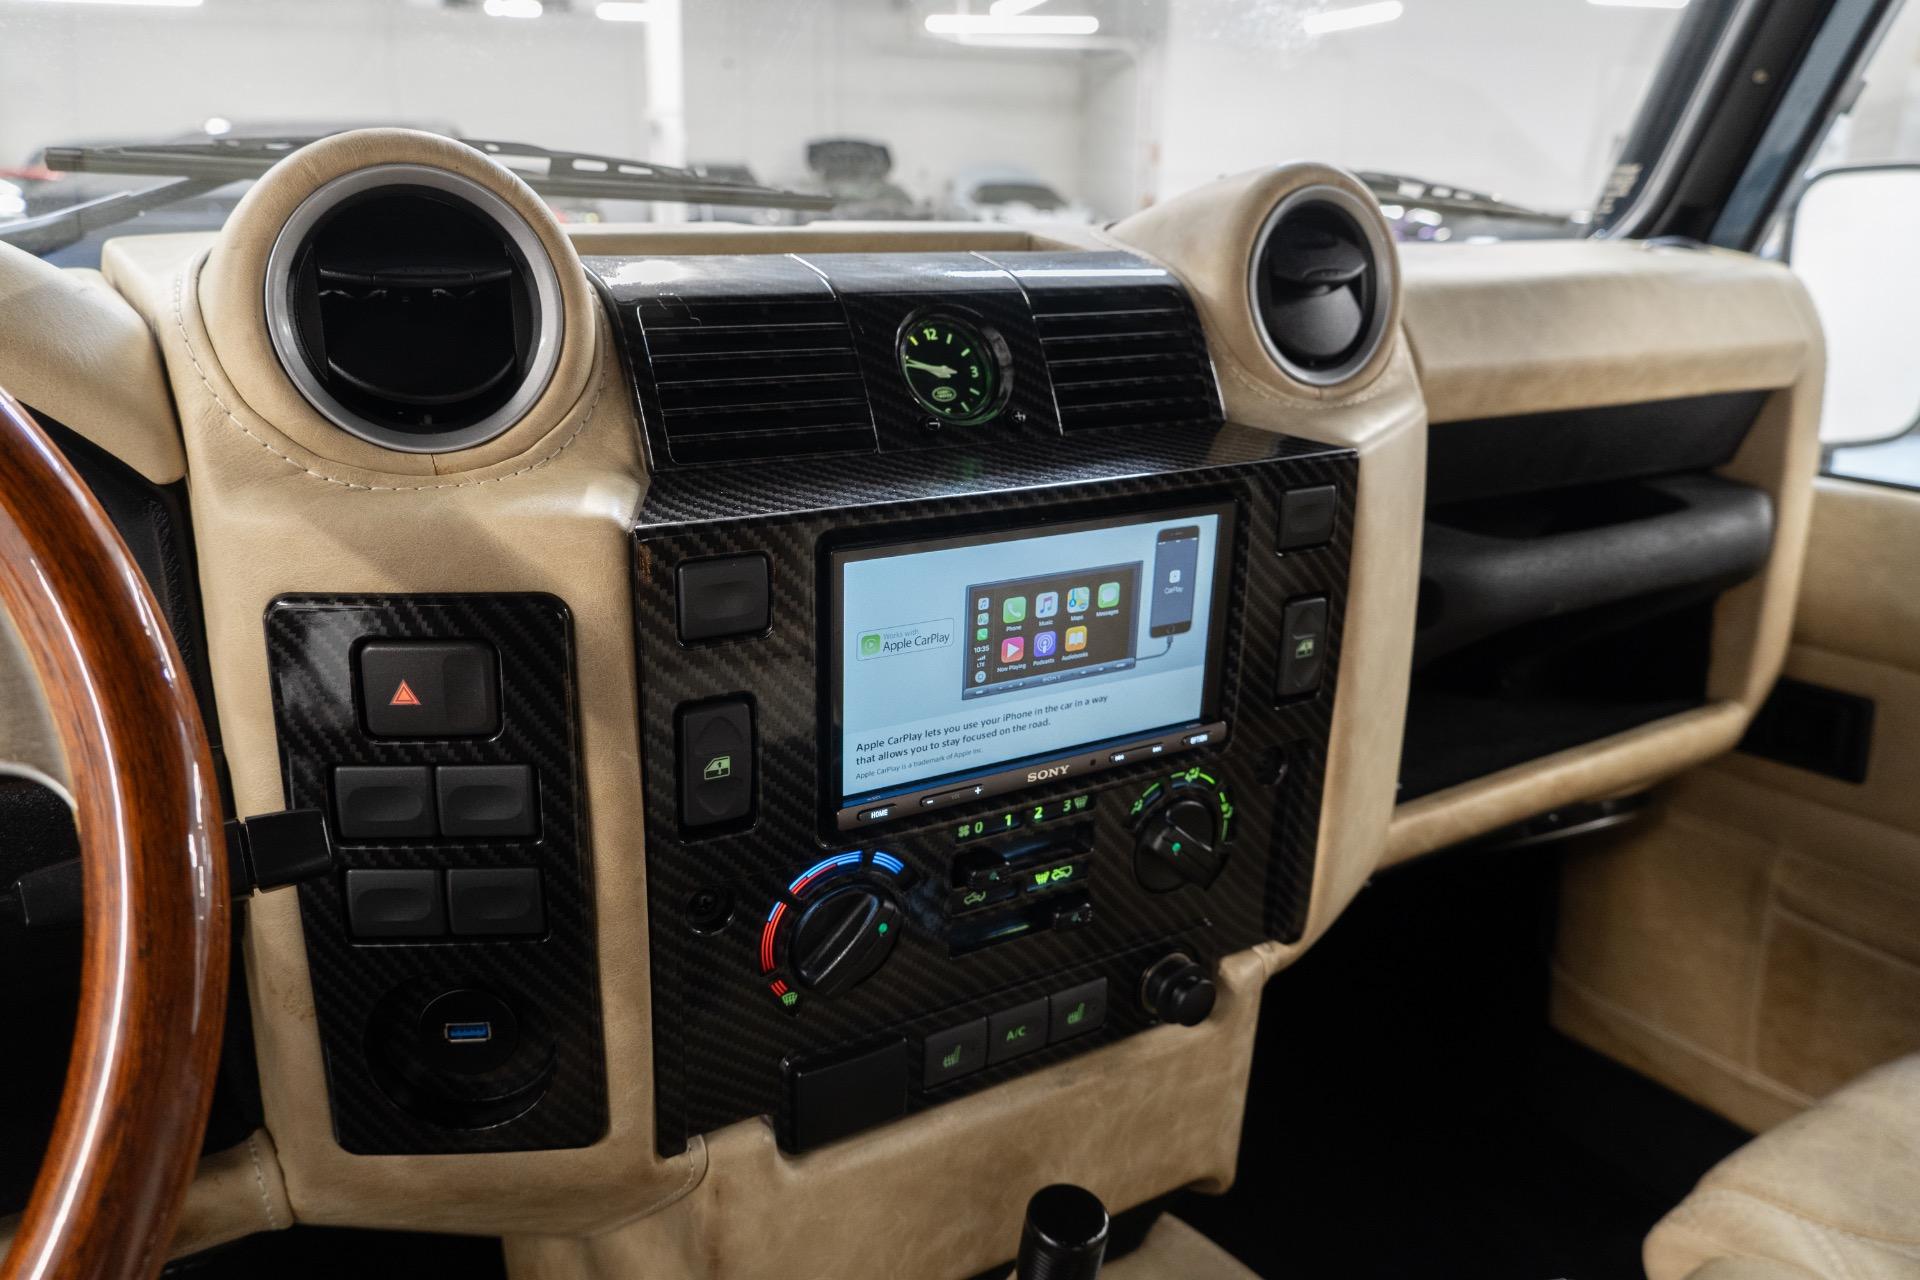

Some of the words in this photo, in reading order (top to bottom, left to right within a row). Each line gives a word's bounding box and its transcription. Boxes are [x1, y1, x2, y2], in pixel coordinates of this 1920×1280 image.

[923, 328, 938, 340] 12
[970, 366, 978, 378] 3
[1038, 619, 1054, 627] Music
[883, 632, 903, 640] Works
[904, 628, 920, 637] with
[882, 638, 912, 653] Apple
[914, 632, 950, 646] CarPlay
[974, 645, 990, 653] 10:35
[1009, 662, 1026, 671] Playing
[1032, 658, 1055, 667] Podcasts
[856, 738, 885, 752] Apple
[887, 732, 922, 746] CarPlay
[925, 728, 942, 738] lets
[943, 725, 961, 736] you
[963, 720, 979, 730] use
[980, 717, 1001, 729] your
[1002, 710, 1033, 723] iPhone
[1034, 706, 1043, 715] in
[1045, 703, 1059, 713] the
[1060, 701, 1073, 711] car
[1074, 699, 1083, 707] in
[1084, 698, 1090, 706] a
[1091, 695, 1108, 704] way
[856, 754, 876, 766] that
[878, 748, 908, 761] allows
[910, 745, 928, 756] you
[930, 741, 940, 750] to
[941, 738, 961, 749] stay
[962, 729, 998, 744] focused
[999, 727, 1011, 736] on
[1012, 723, 1027, 733] the
[1028, 718, 1052, 729] road.
[855, 770, 875, 780] Apple
[876, 765, 900, 776] CarPlay
[913, 755, 945, 767] trademark
[954, 749, 971, 760] Apple
[1027, 765, 1070, 783] SONY
[1063, 799, 1071, 812] 3
[871, 808, 888, 819] HOME
[1034, 807, 1043, 820] 2
[1004, 814, 1012, 827] 1
[974, 822, 983, 834] 0
[1007, 1026, 1025, 1041] A/C
